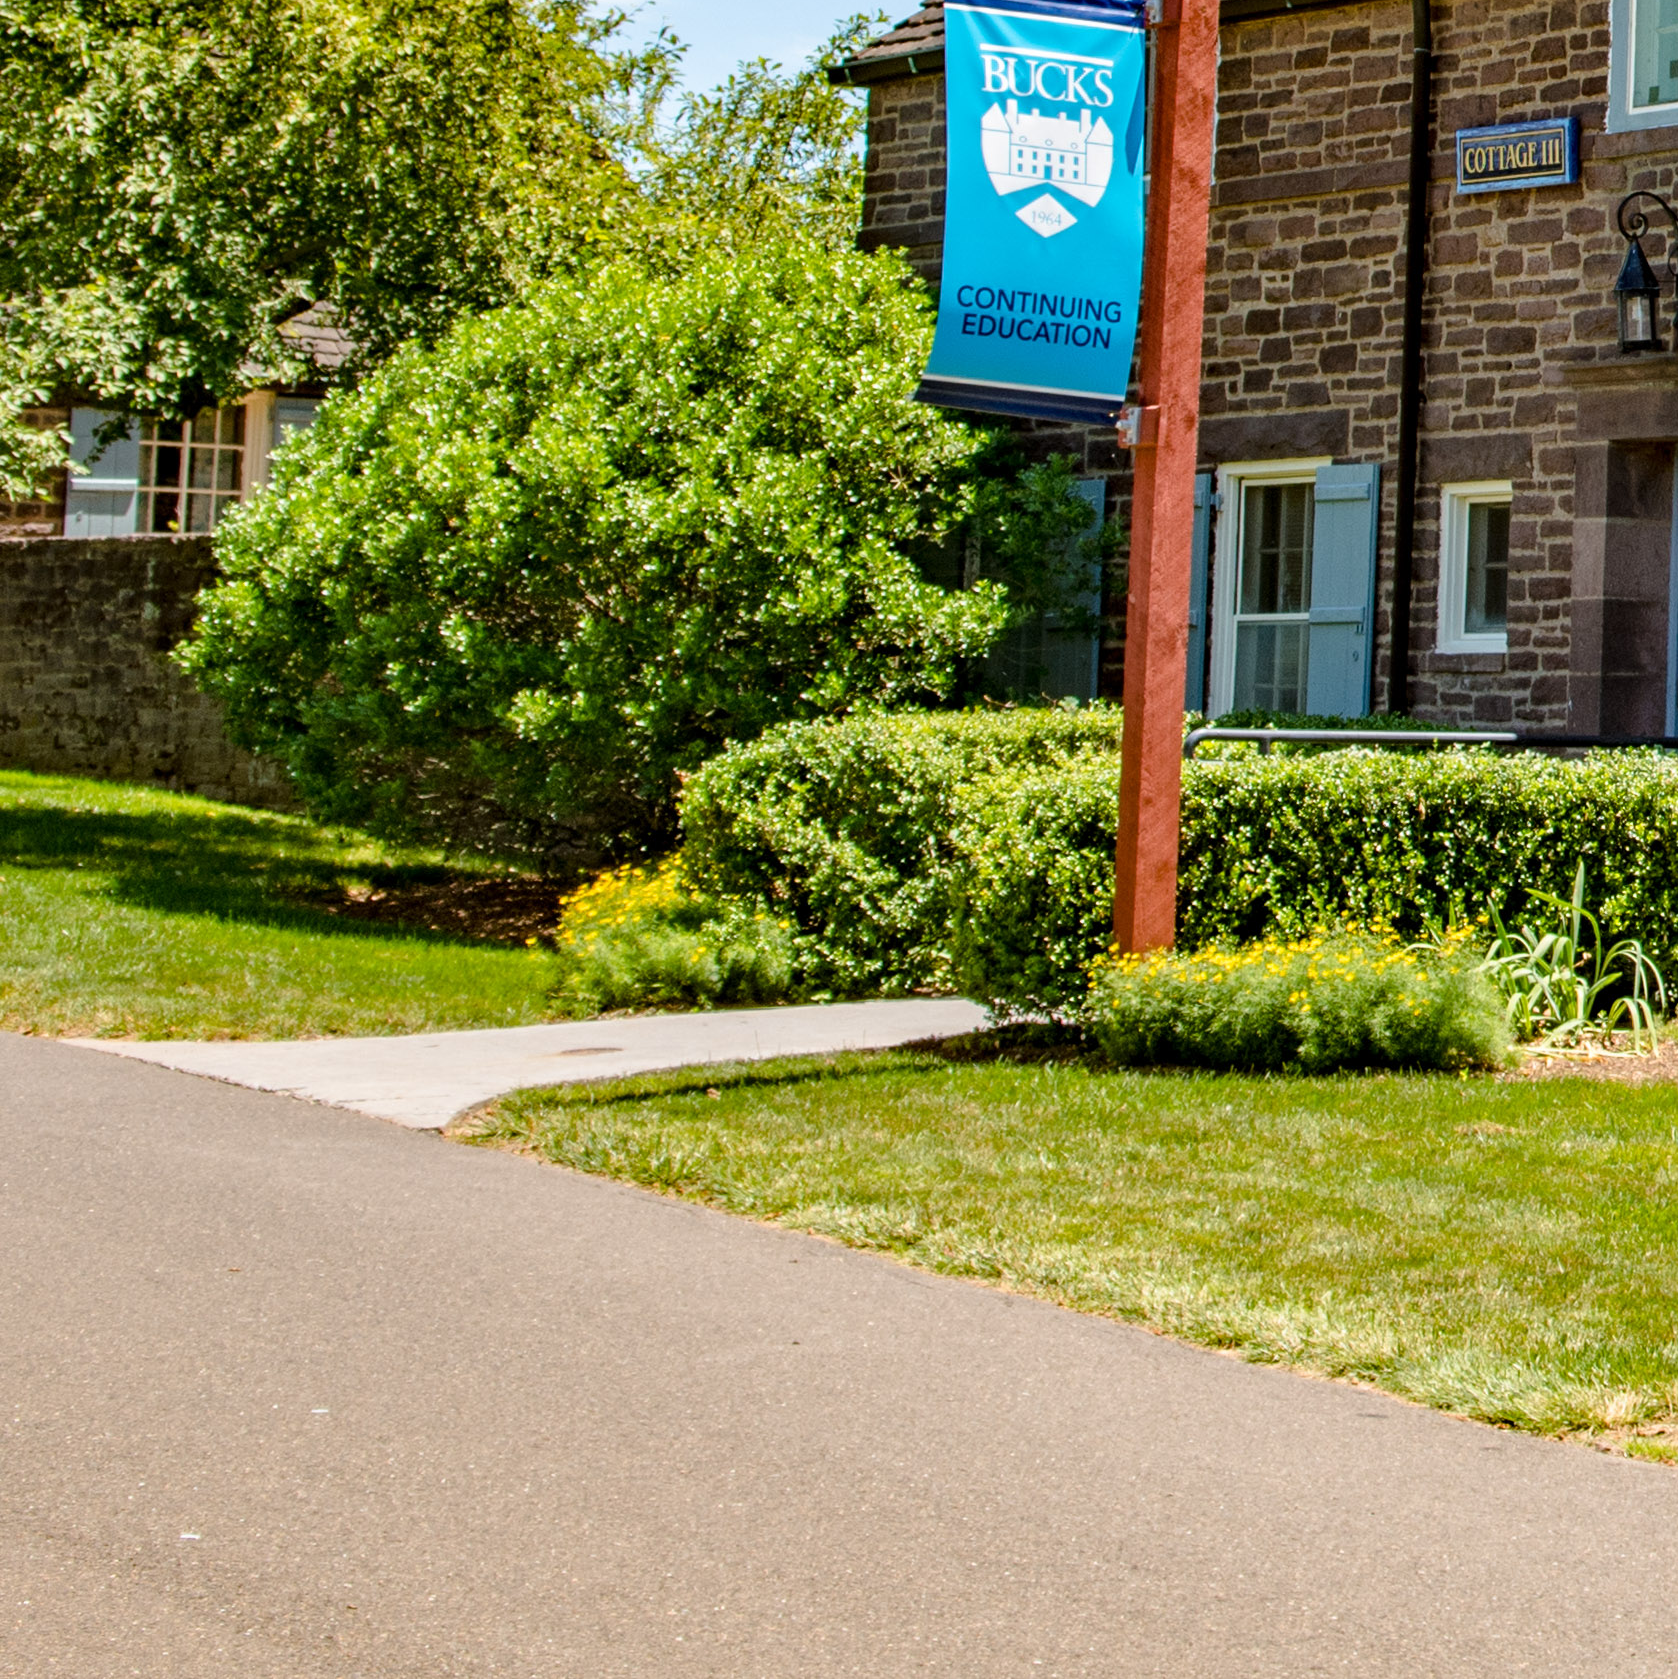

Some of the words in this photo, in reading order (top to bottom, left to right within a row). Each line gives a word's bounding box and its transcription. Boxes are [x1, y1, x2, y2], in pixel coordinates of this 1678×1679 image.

[981, 55, 1114, 108] BUCKS
[1465, 142, 1537, 173] COTTAGE
[1542, 140, 1560, 165] III
[1030, 209, 1063, 228] 1964
[957, 285, 1122, 323] CONTINUING
[961, 313, 1112, 349] EDUCATION
